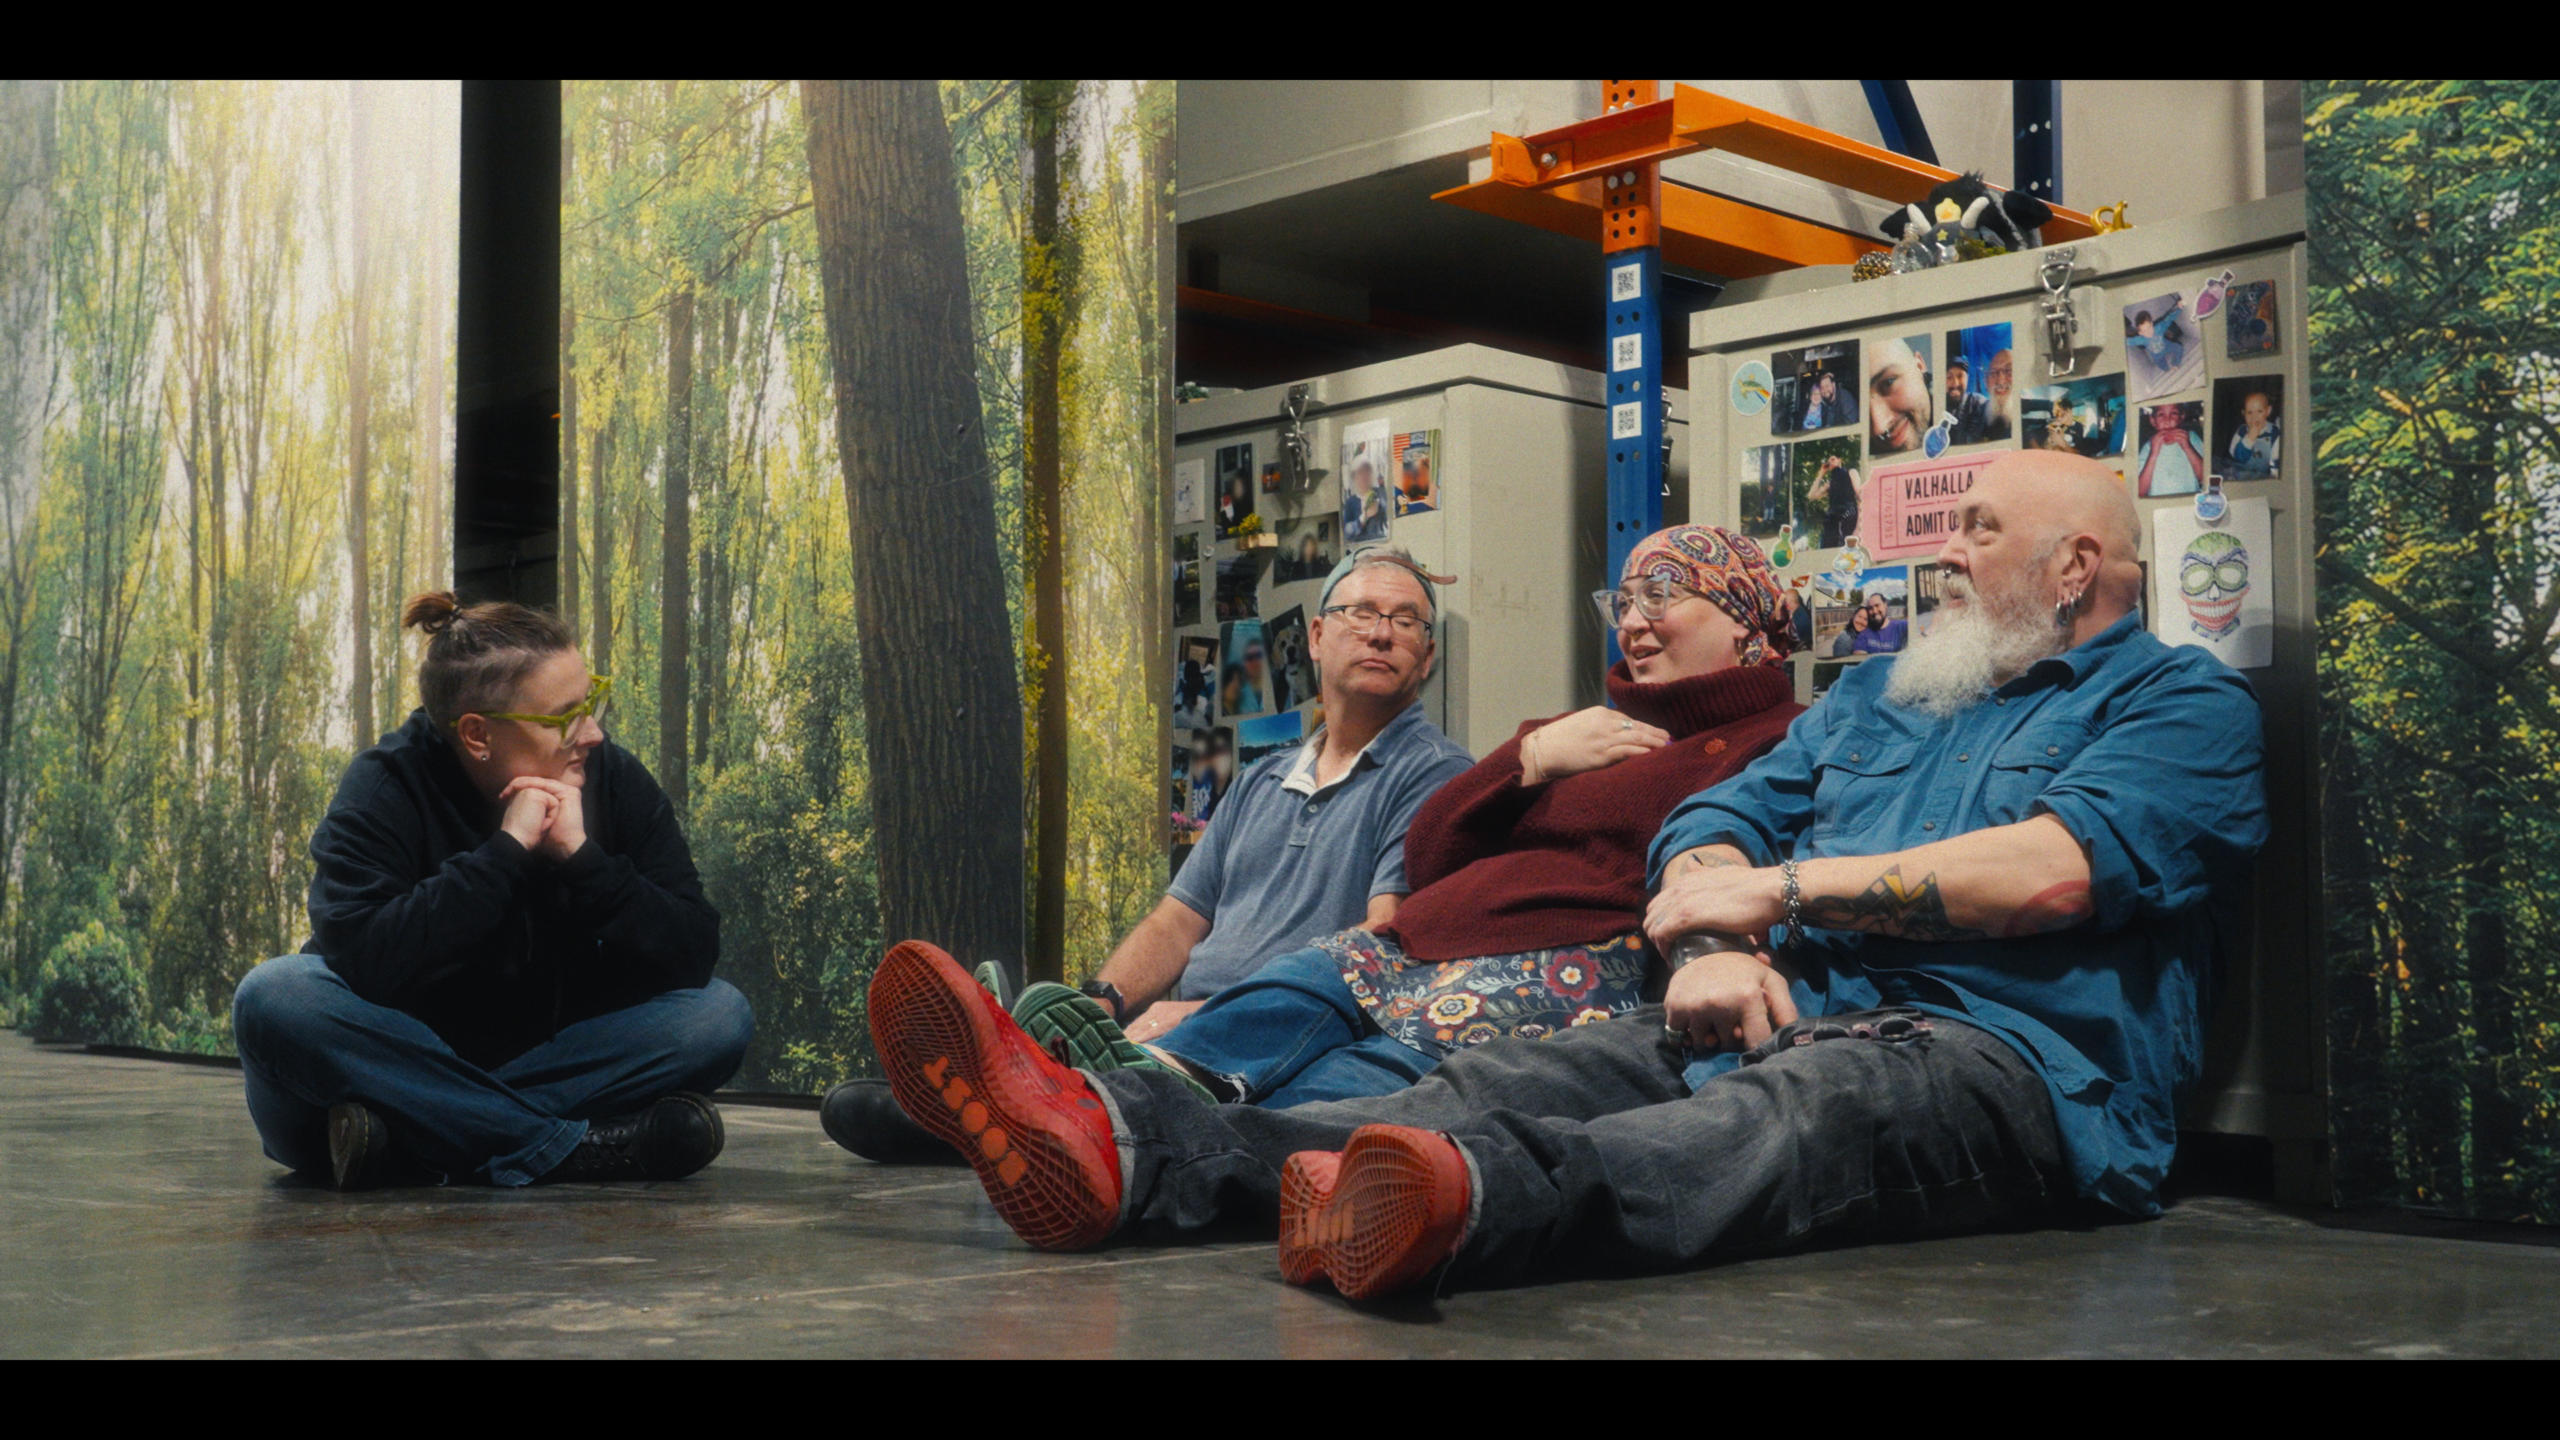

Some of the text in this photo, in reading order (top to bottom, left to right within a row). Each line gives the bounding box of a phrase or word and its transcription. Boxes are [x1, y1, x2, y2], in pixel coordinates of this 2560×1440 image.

[1905, 470, 1974, 500] VALHALLA
[1906, 509, 1960, 537] ADMIT O
